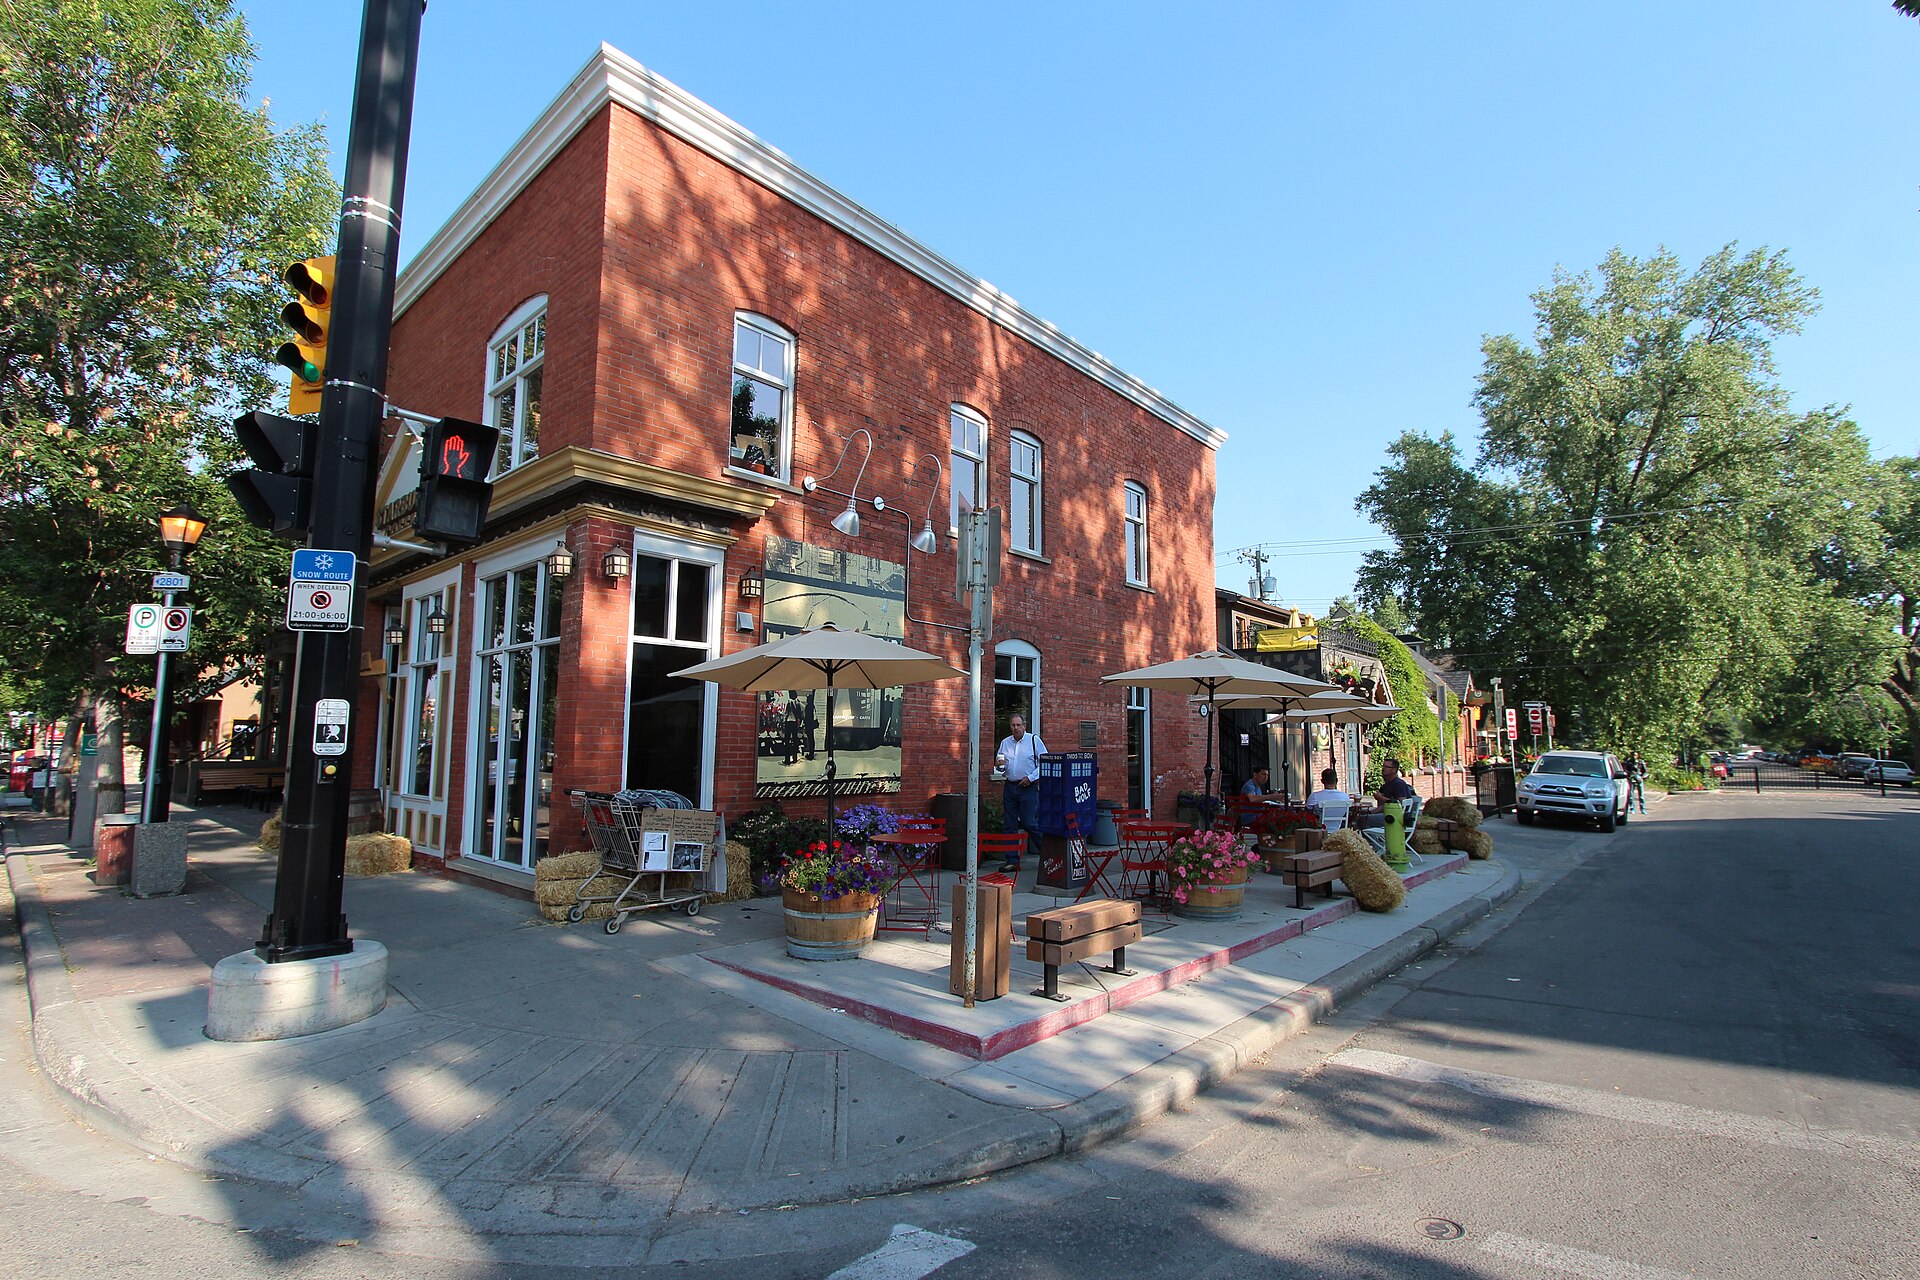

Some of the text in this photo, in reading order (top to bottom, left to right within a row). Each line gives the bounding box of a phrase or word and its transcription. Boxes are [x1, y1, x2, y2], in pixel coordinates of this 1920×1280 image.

[297, 570, 349, 580] SNOW ROUTE
[160, 578, 183, 586] 2801
[140, 611, 152, 625] P
[293, 611, 346, 620] 21:00-06:00
[1074, 782, 1088, 797] BAD
[1075, 787, 1091, 804] WOLF
